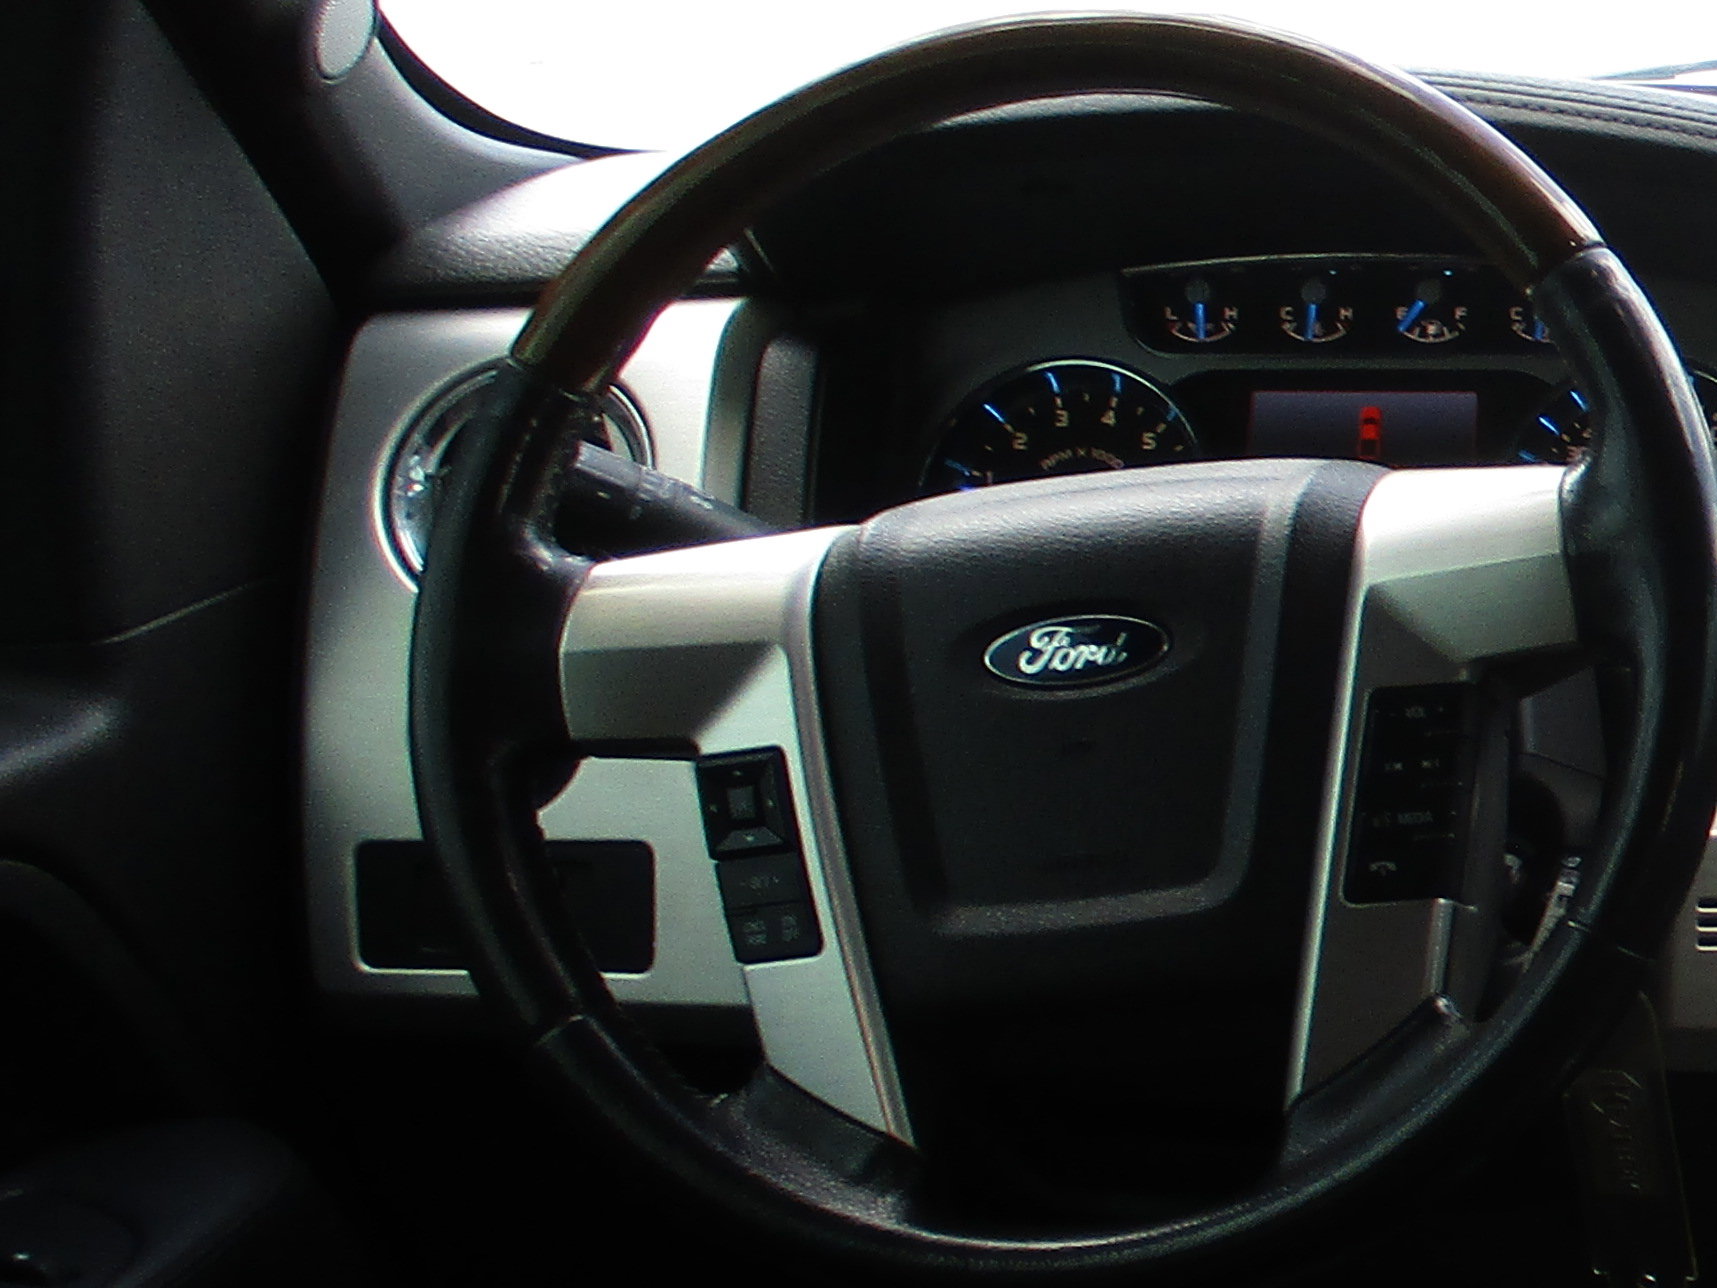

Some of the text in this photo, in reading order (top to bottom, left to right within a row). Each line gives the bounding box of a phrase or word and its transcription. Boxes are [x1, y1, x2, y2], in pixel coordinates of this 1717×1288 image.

[1054, 409, 1070, 427] 3
[1100, 409, 1116, 427] 4
[1012, 432, 1029, 451] 2
[1141, 431, 1157, 450] 5
[1017, 622, 1131, 677] Ford
